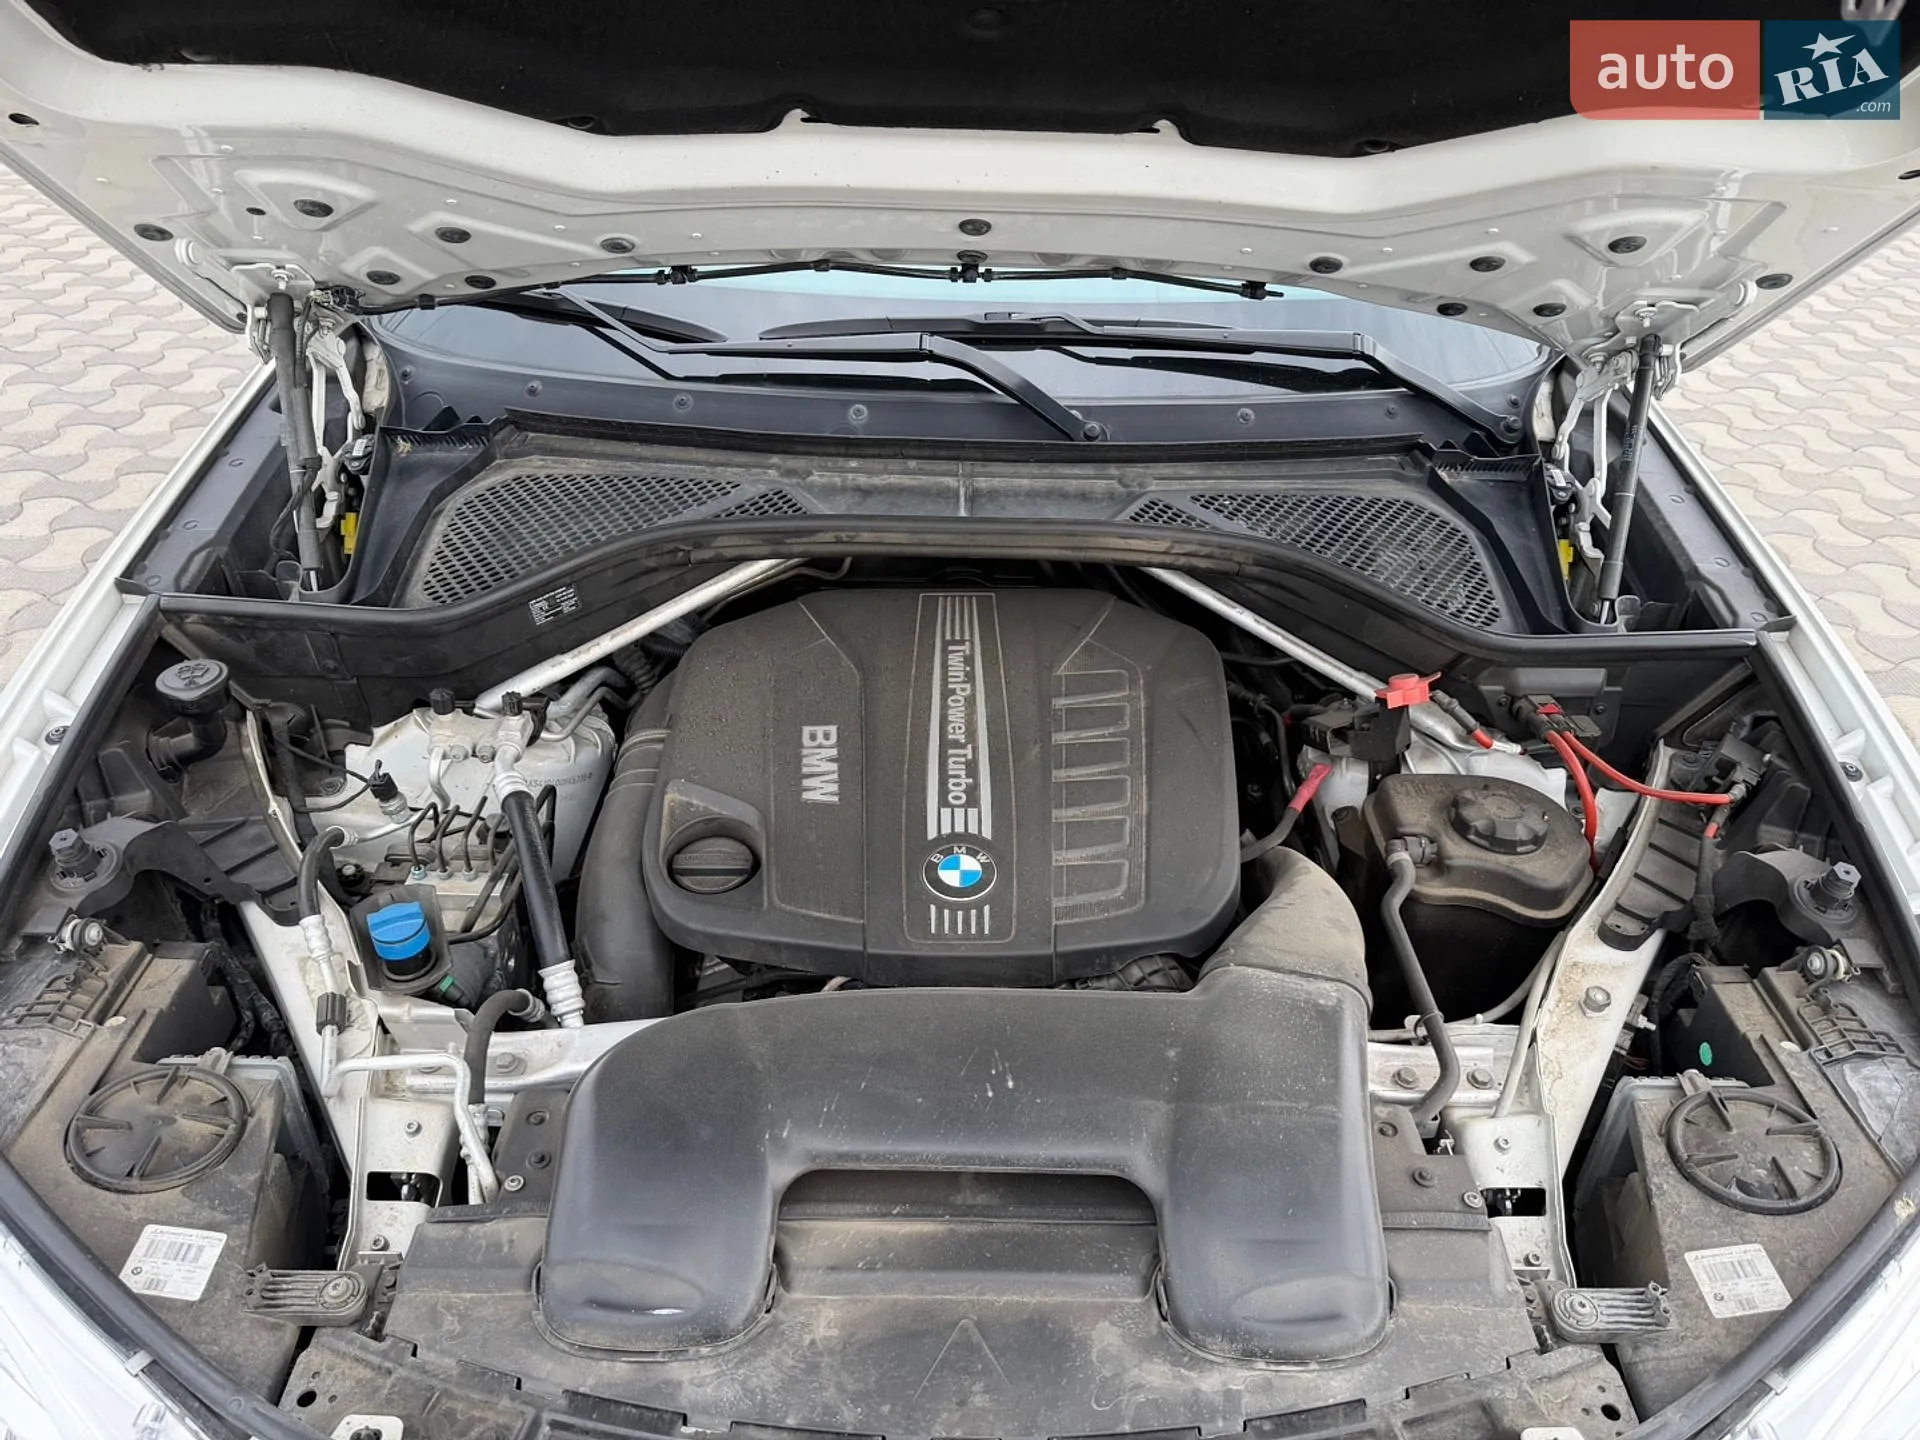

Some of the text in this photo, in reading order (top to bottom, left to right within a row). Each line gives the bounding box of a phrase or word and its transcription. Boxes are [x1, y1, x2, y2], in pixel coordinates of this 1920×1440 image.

[947, 641, 973, 804] TwinPower Turbo
[801, 725, 840, 804] BMW
[930, 846, 990, 863] BMW
